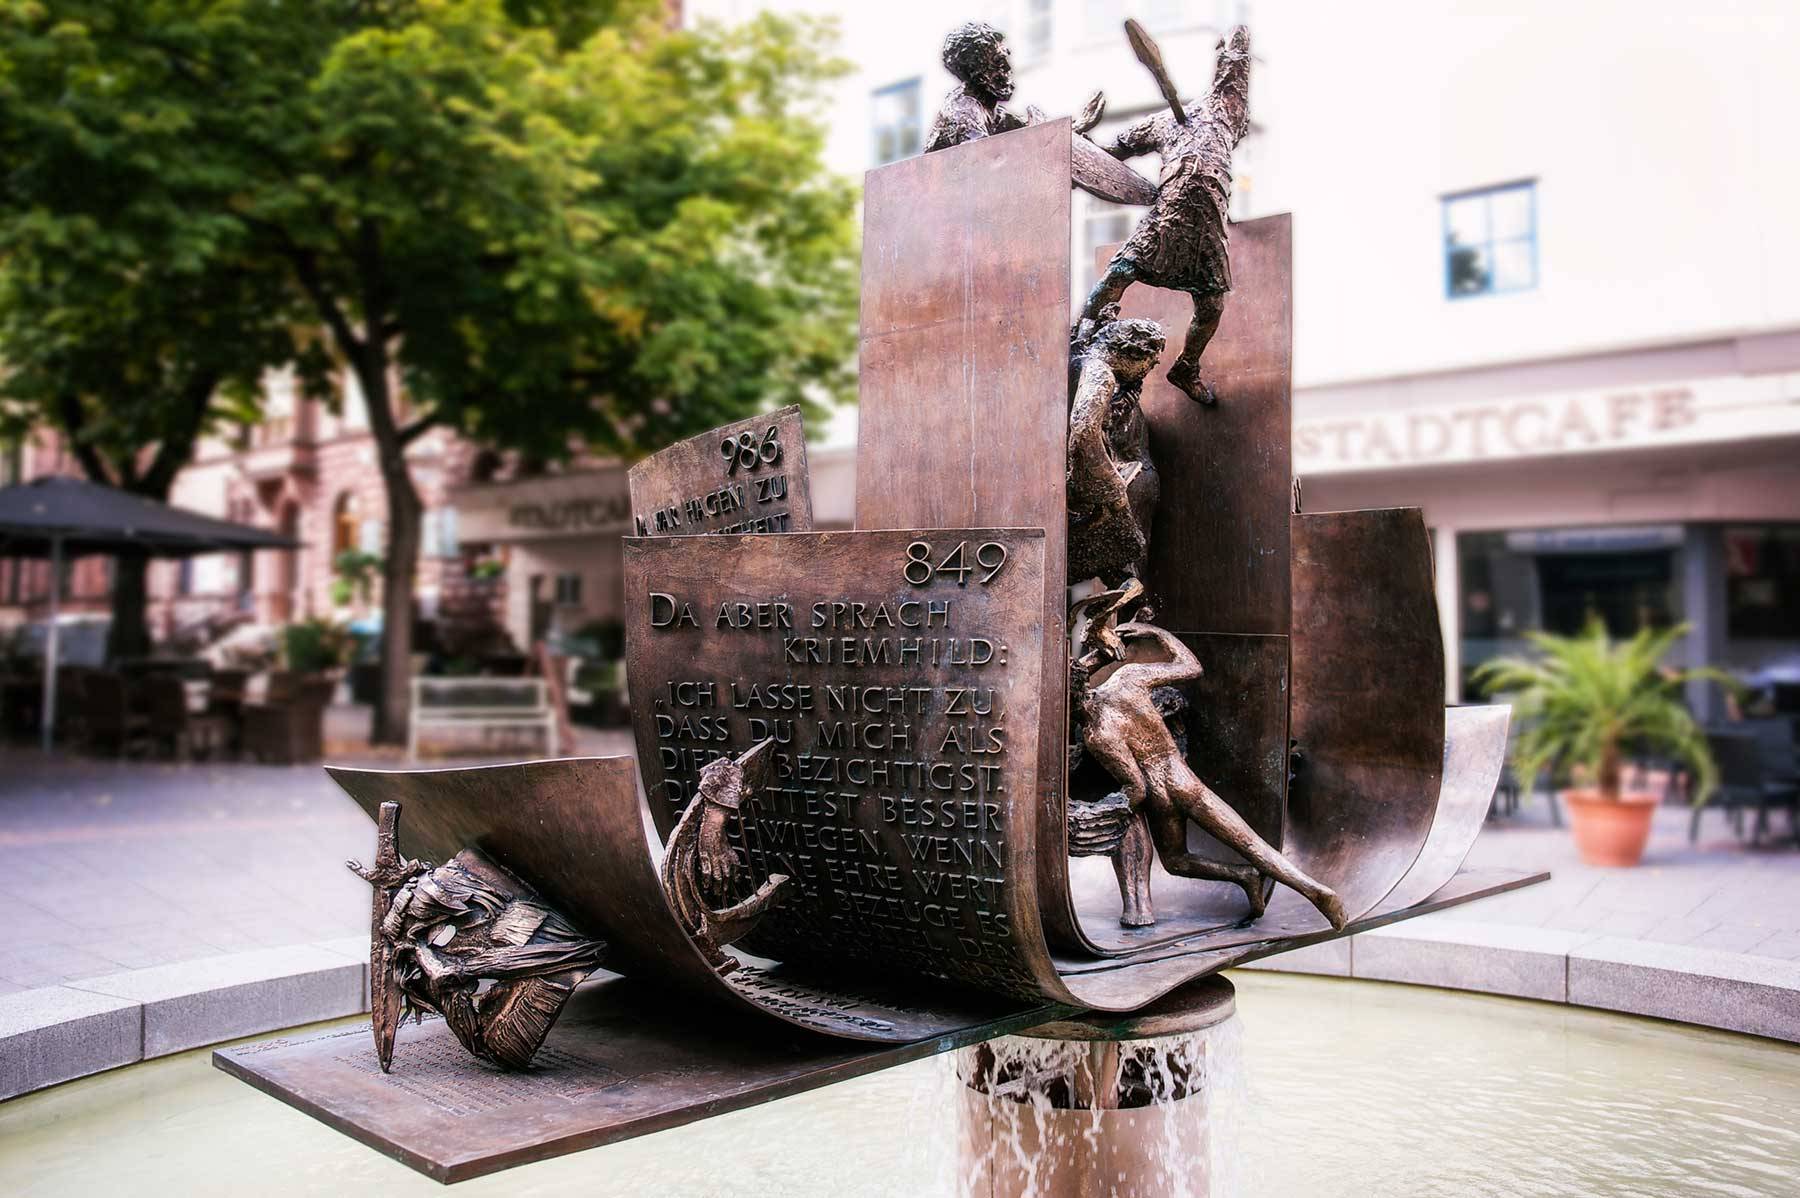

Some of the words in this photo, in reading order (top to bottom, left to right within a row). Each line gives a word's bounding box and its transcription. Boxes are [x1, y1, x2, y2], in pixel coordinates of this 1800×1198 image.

[720, 424, 778, 476] 986
[755, 475, 787, 503] ZU
[904, 541, 1008, 585] 849
[649, 592, 698, 627] DA
[714, 602, 792, 628] ABER
[811, 601, 950, 628] SPRACH
[784, 638, 1008, 666] KRIEMHILD:
[730, 682, 813, 711] LASSE
[826, 685, 932, 714] NICHT
[655, 714, 729, 741] DASS
[748, 718, 793, 744] DU
[817, 721, 910, 751] MICH
[879, 794, 1004, 832] BESSER
[900, 833, 1005, 868] WENN
[825, 858, 903, 891] EHRE
[911, 869, 1006, 905] WERT
[975, 911, 1010, 938] ES
